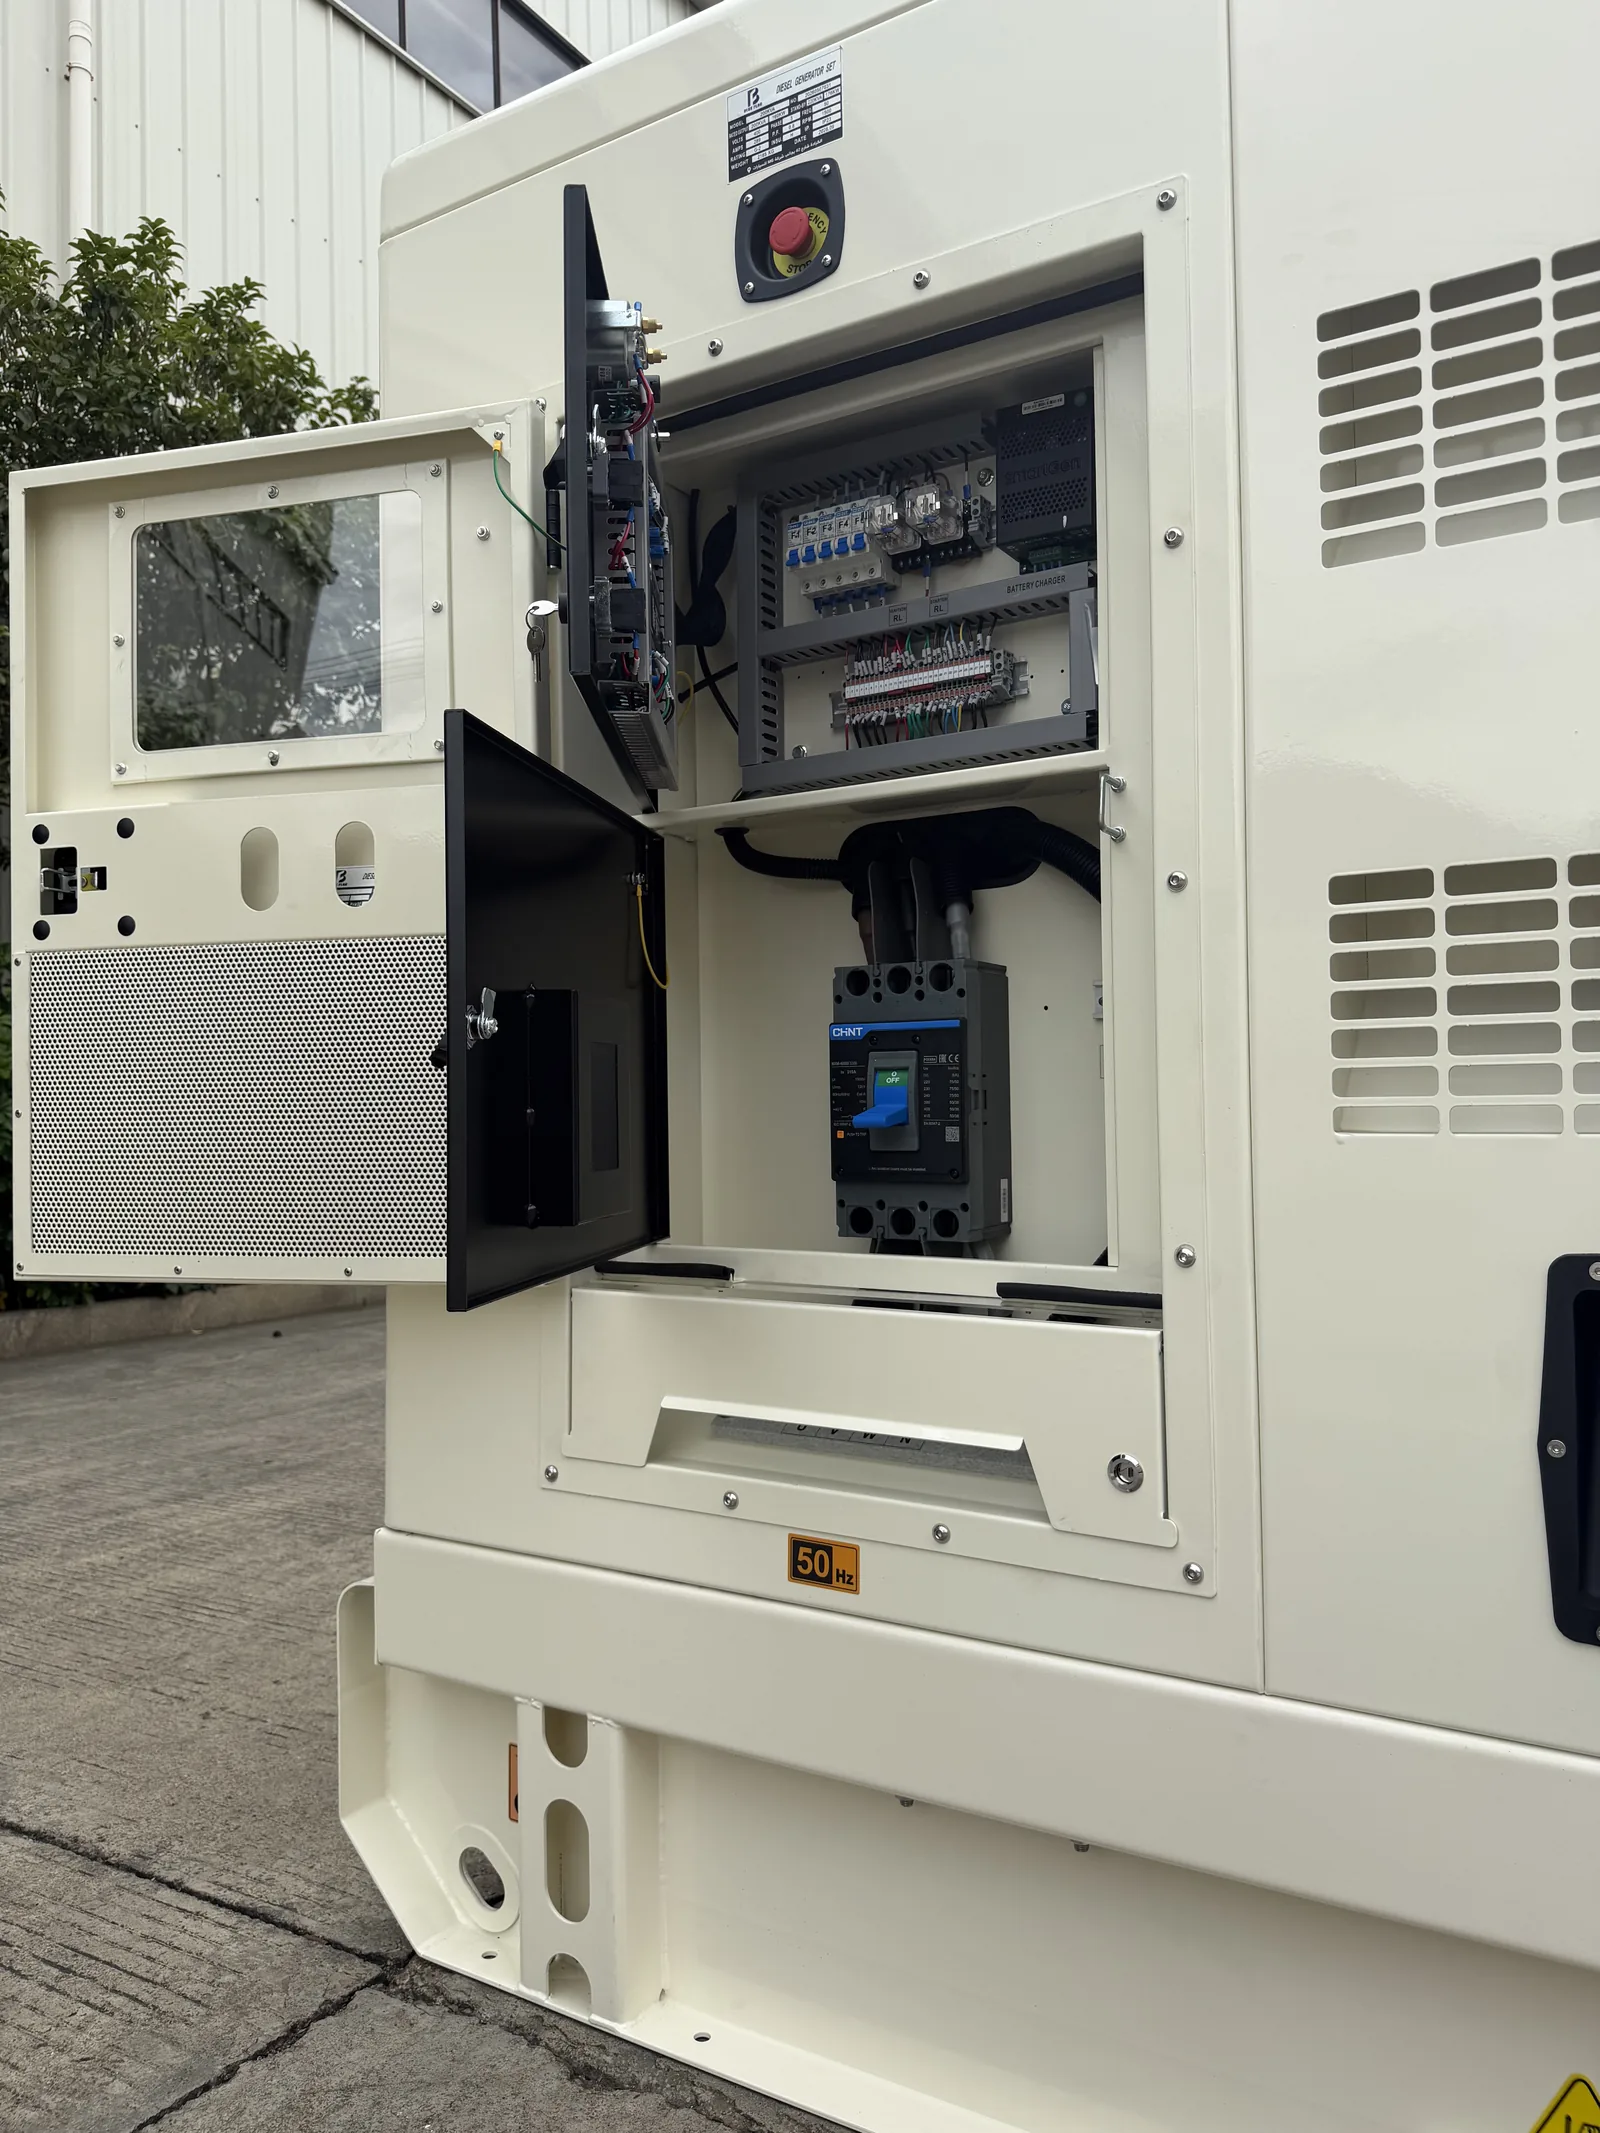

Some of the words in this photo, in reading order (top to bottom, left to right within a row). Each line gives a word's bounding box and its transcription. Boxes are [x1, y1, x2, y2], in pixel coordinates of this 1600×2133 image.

[776, 80, 792, 94] DIESEL
[794, 66, 824, 86] GENERATOR
[826, 61, 836, 72] SET
[770, 120, 781, 129] PHASE
[732, 136, 742, 145] VOLTS
[794, 135, 806, 144] DATE
[732, 144, 743, 153] AMPS
[730, 151, 745, 162] RATING
[730, 158, 748, 170] WEIGHT
[823, 524, 832, 532] F3
[839, 520, 849, 528] F4
[791, 530, 800, 539] F1
[807, 527, 816, 536] F2
[1007, 581, 1034, 593] BATTERY
[1035, 575, 1065, 588] CHARGER
[893, 614, 902, 622] RL
[797, 1546, 829, 1577] 50
[836, 1568, 854, 1585] Hz
